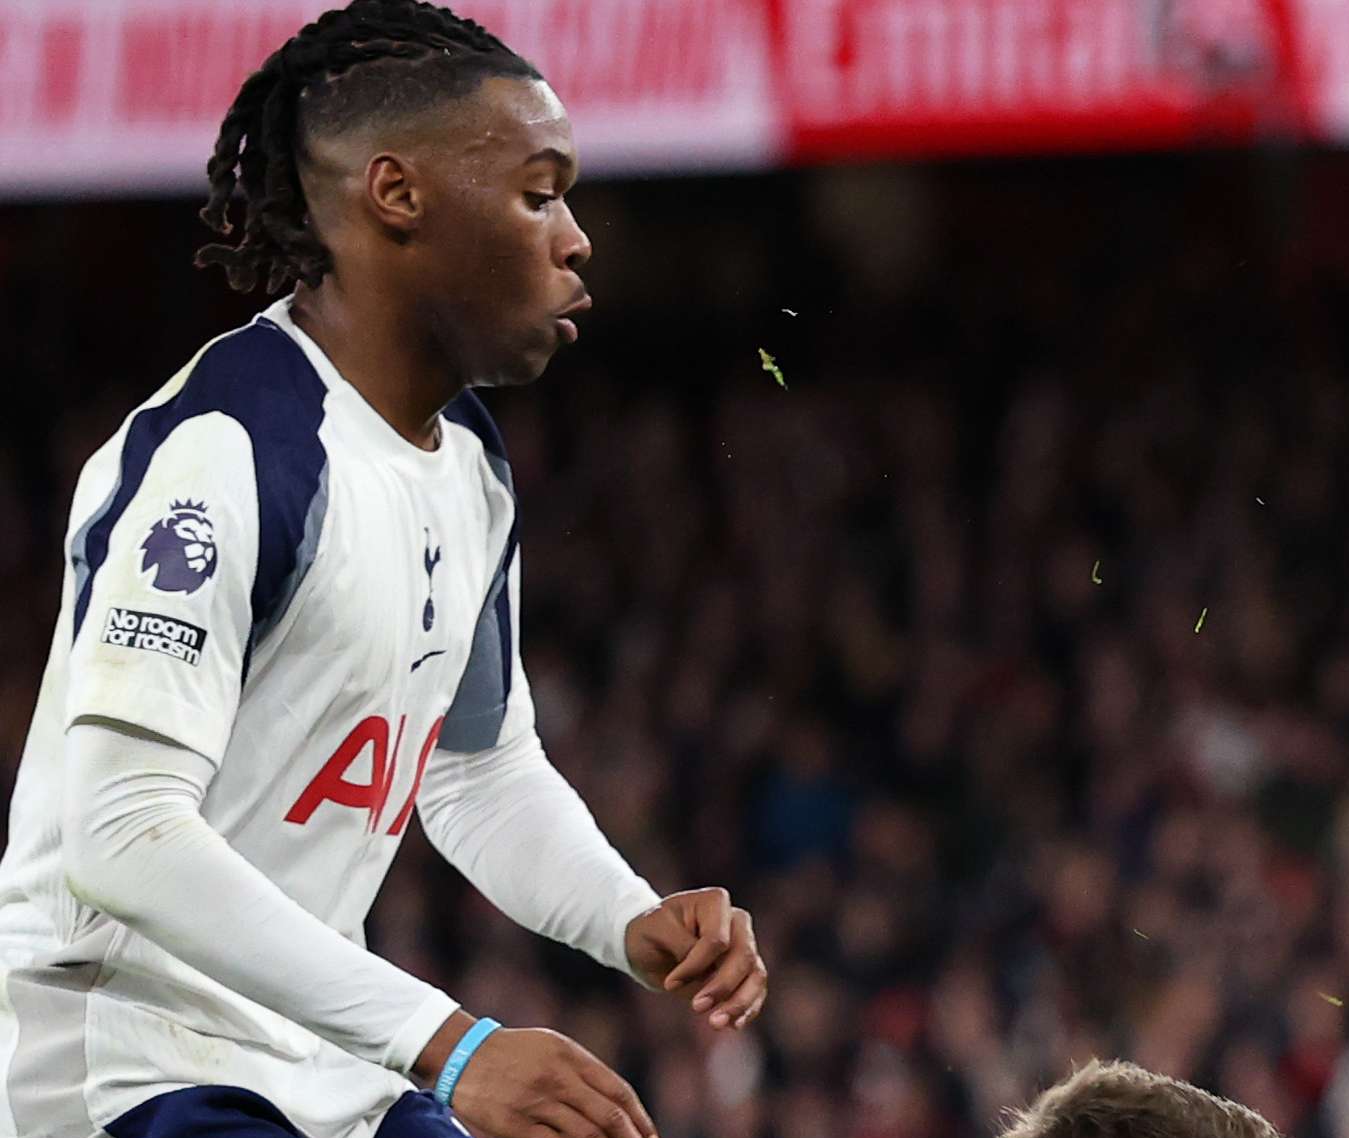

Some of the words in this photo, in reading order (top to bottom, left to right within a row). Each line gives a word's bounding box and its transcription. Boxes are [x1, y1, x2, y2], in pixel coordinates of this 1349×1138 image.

[105, 608, 139, 630] No
[139, 616, 198, 646] room
[134, 632, 200, 667] racism
